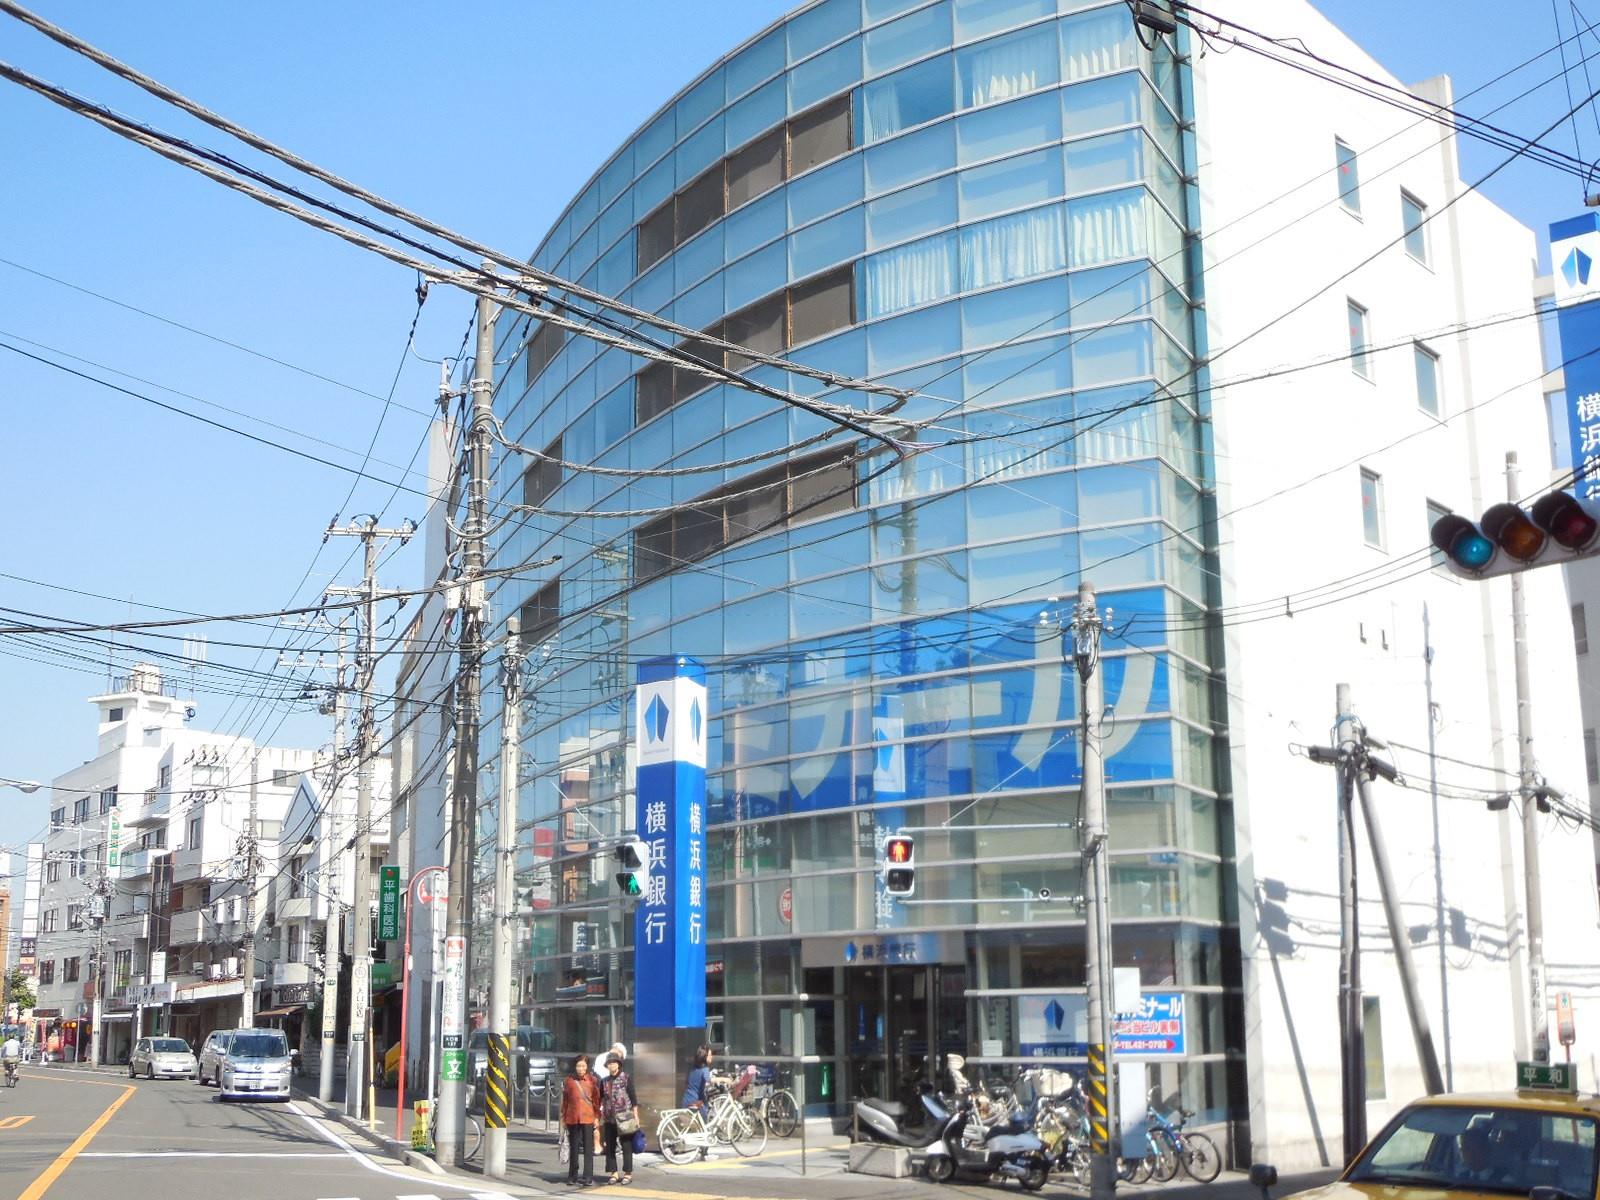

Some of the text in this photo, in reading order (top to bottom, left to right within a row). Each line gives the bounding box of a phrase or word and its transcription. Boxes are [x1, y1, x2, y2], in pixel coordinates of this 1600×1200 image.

[645, 802, 668, 945] 横浜銀行
[688, 801, 704, 946] 横浜銀行
[382, 879, 396, 938] 平歯科医院
[862, 941, 917, 961] 横浜銀行
[1523, 1066, 1563, 1084] 平和
